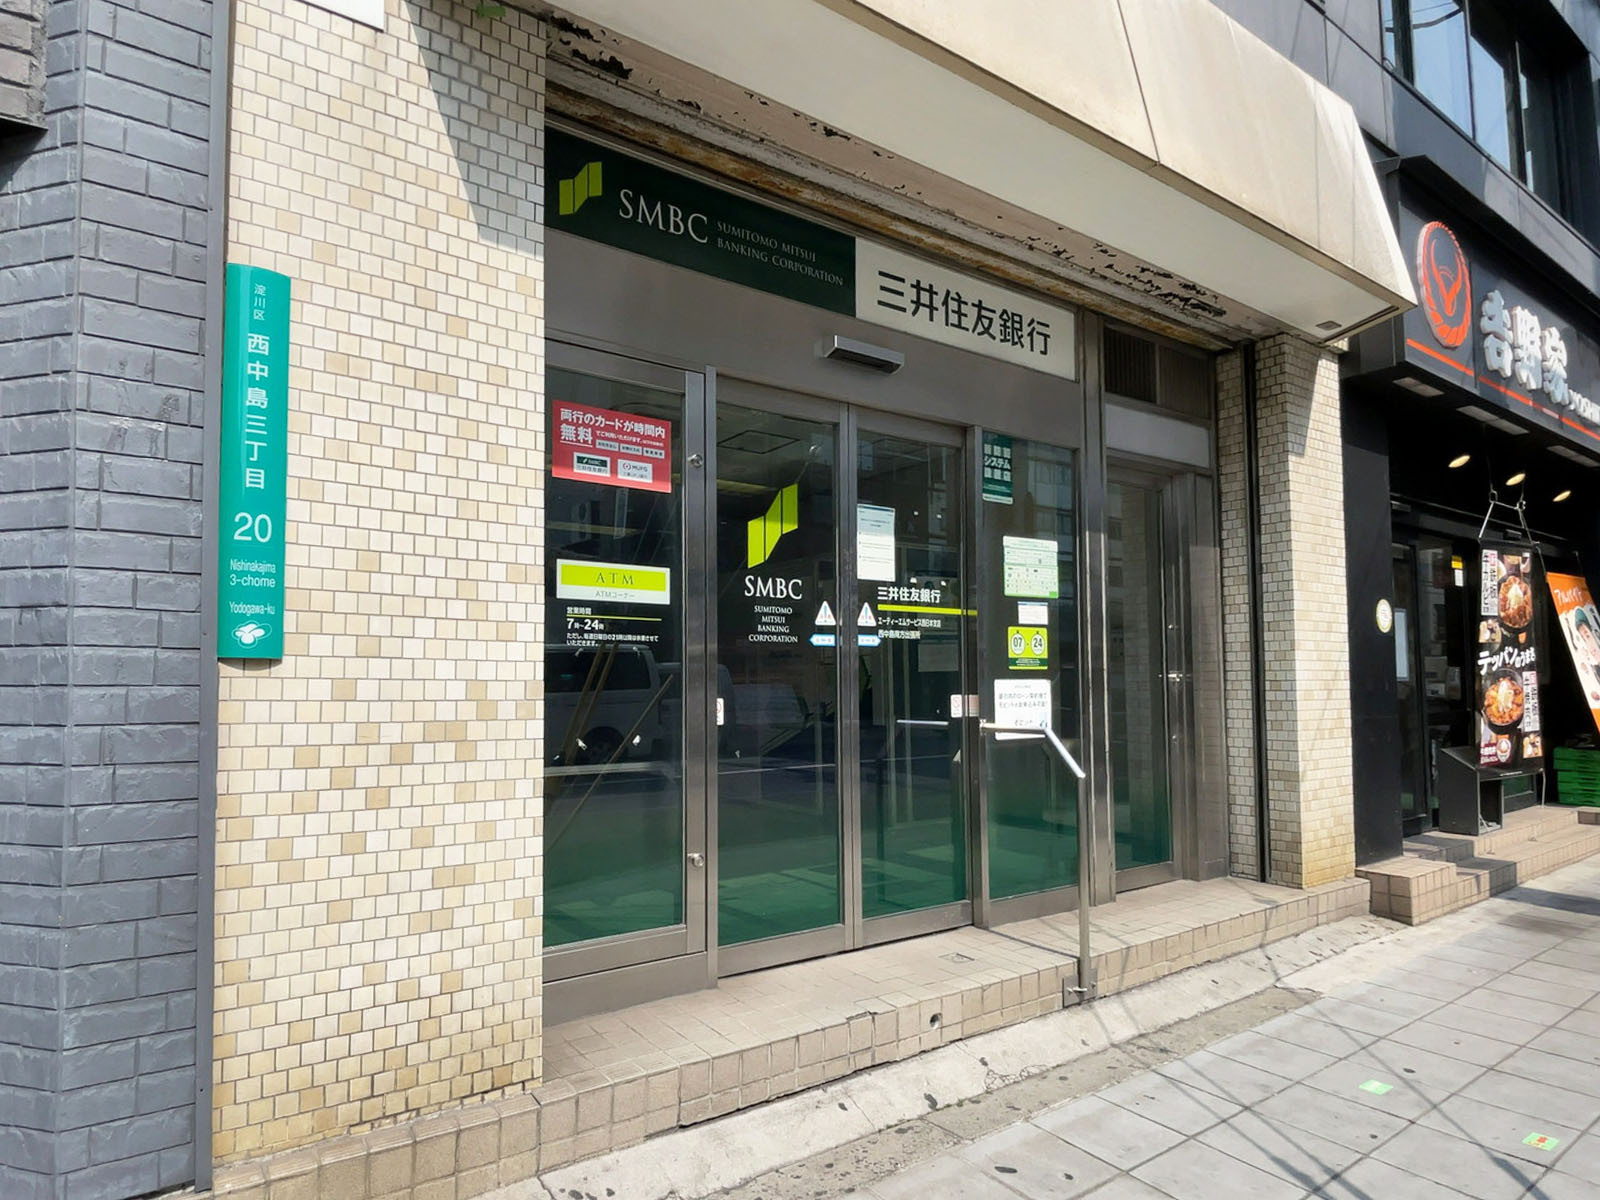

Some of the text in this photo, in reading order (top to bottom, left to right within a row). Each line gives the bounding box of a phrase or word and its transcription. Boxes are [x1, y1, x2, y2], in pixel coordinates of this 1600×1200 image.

[618, 188, 709, 244] SMBC
[716, 220, 817, 263] SUMITOMO MITSUI
[717, 237, 844, 286] BANKING CORPORATION
[253, 282, 266, 321] 淀川区
[877, 269, 1051, 356] 三井住友銀行
[244, 332, 270, 490] 西中島三丁目
[561, 408, 665, 438] 両行のカードが時間内
[560, 423, 593, 445] 無料
[984, 455, 1011, 470] システム
[233, 511, 273, 543] 20
[229, 558, 276, 575] Nishinakajima
[229, 573, 275, 588] 3-chome
[596, 572, 635, 586] ATM
[744, 575, 803, 600] SMBC
[595, 590, 635, 599] ATMコーナー
[877, 585, 942, 604] 三井住友銀行
[228, 600, 275, 616] Yodogawa-ku
[754, 605, 793, 615] SUMITOMO
[761, 615, 786, 624] MITSUI
[757, 624, 790, 634] BANKING
[748, 634, 799, 643] CORPORATION
[1012, 636, 1043, 648] 07 24
